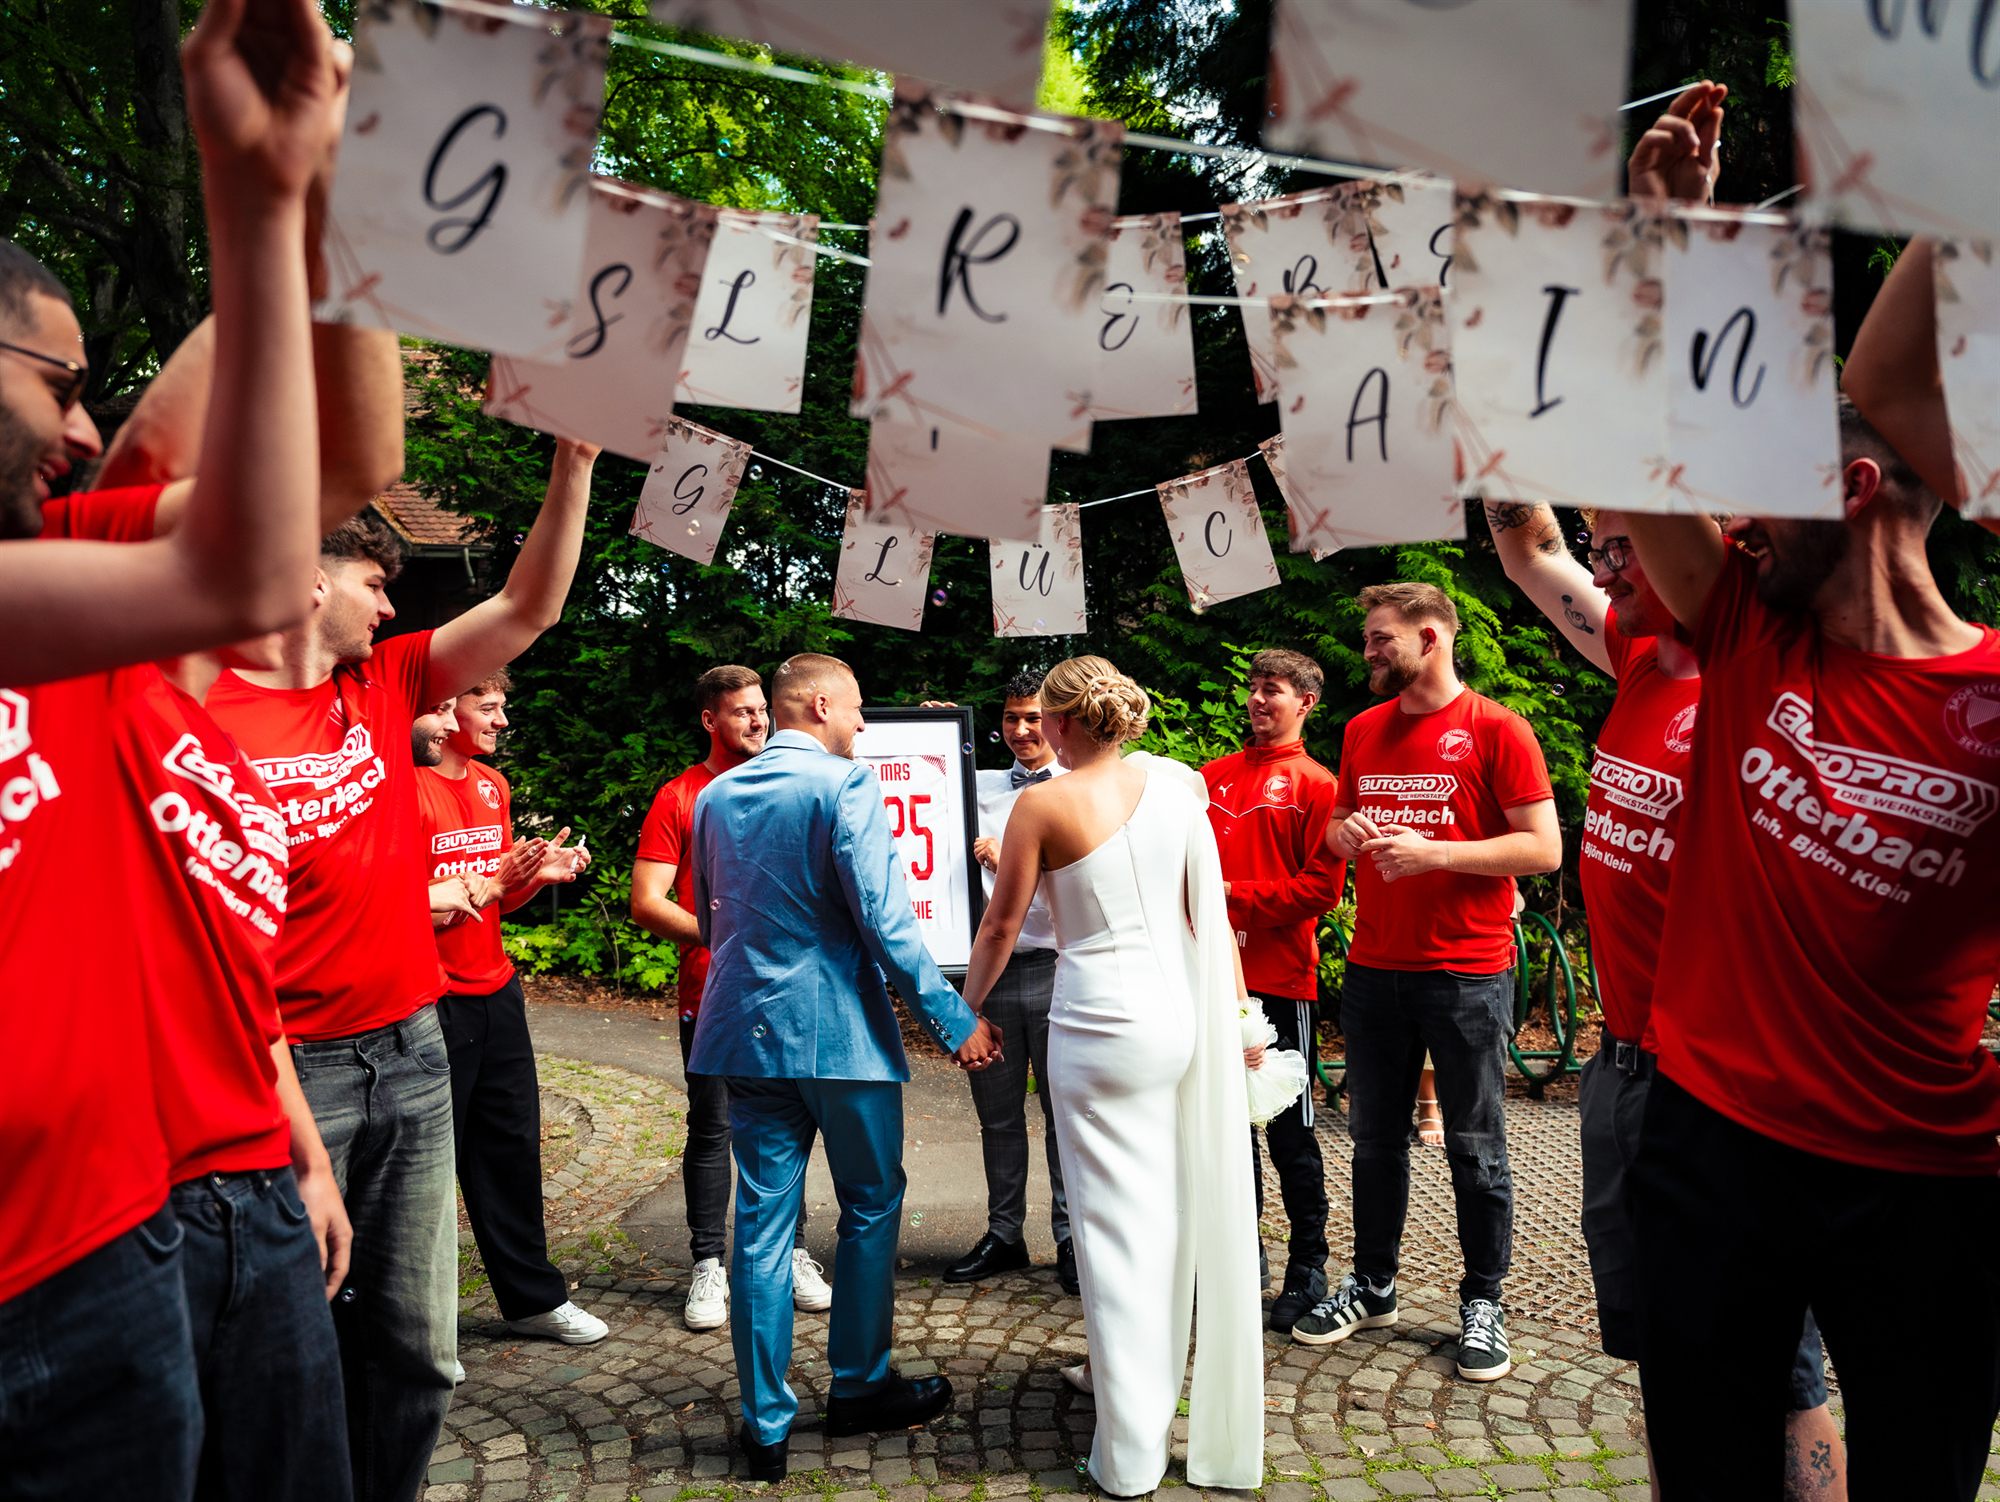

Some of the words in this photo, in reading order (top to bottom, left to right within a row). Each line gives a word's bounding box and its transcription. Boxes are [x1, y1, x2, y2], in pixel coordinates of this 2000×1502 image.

[424, 104, 507, 255] G
[565, 263, 632, 359] S
[704, 268, 761, 345] L
[938, 206, 1020, 324] R
[1529, 284, 1582, 418] I
[1345, 367, 1389, 463] A
[672, 463, 710, 515] G
[864, 536, 901, 587] L
[1018, 542, 1055, 598] Ü
[1202, 510, 1233, 559] C
[881, 763, 910, 781] MRS
[1740, 747, 1967, 887] Otterbach
[1840, 790, 1867, 803] DIE
[1872, 797, 1970, 832] WERKSTATT
[1603, 851, 1632, 873] Klein
[1751, 808, 1784, 840] Inh.
[1789, 833, 1847, 876] Björn
[1850, 868, 1911, 904] Klein
[912, 900, 933, 919] HIE
